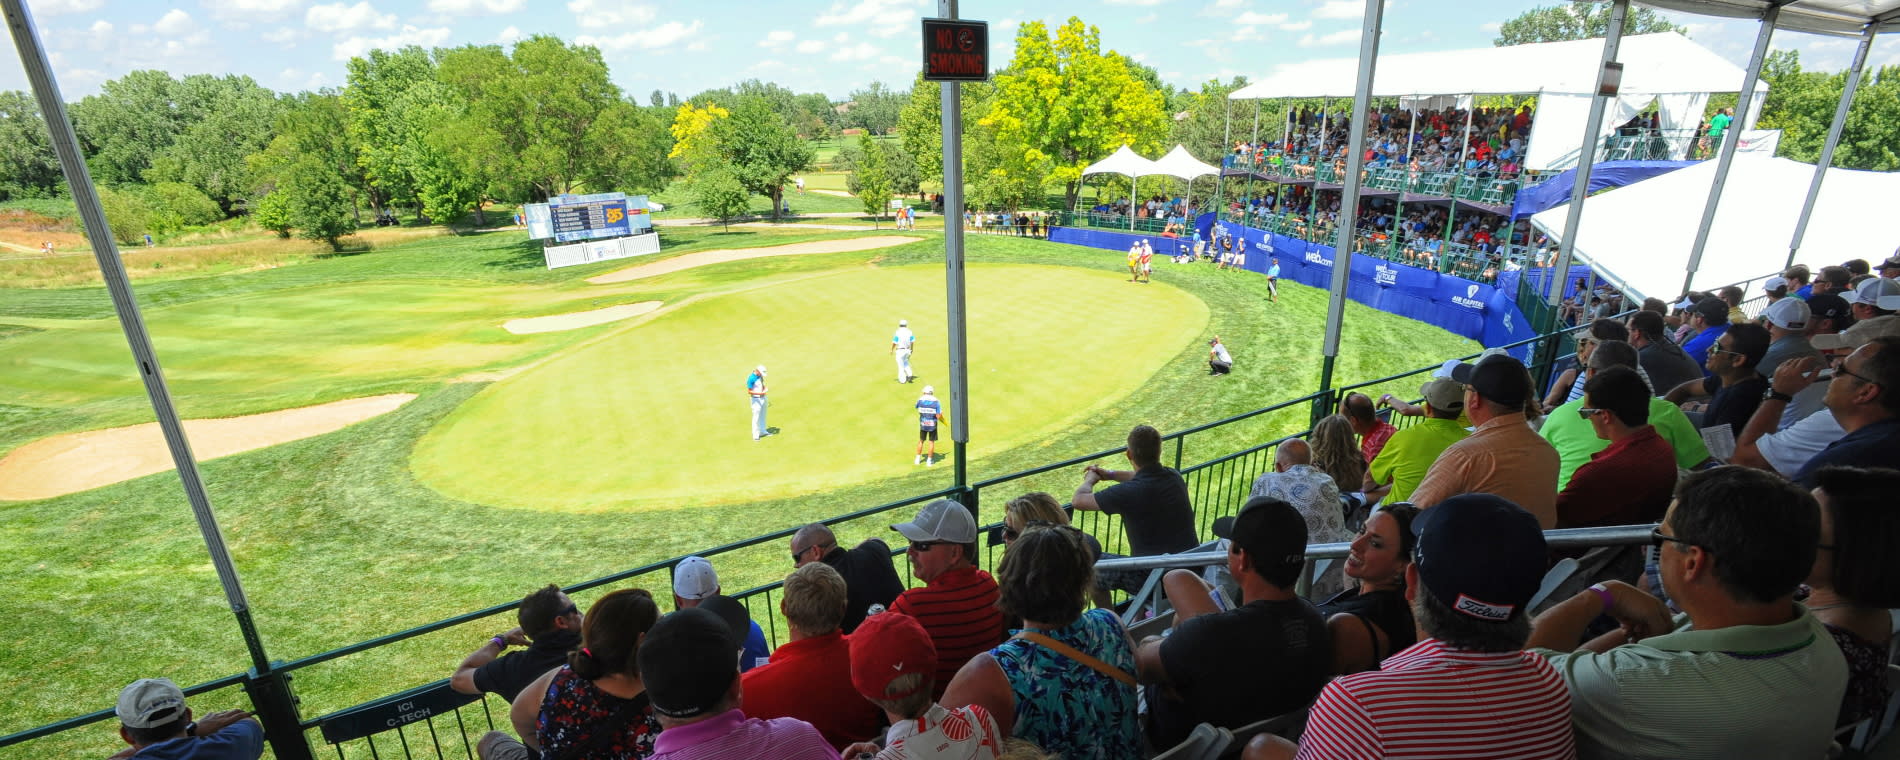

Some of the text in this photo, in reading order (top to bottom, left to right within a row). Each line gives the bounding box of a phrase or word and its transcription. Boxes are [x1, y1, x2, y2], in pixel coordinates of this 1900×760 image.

[936, 28, 953, 49] NO
[930, 52, 983, 74] SMOKING
[1305, 249, 1333, 267] web.com
[1458, 600, 1508, 618] Titleist
[397, 701, 414, 712] ICI
[386, 708, 431, 726] C-TECH
